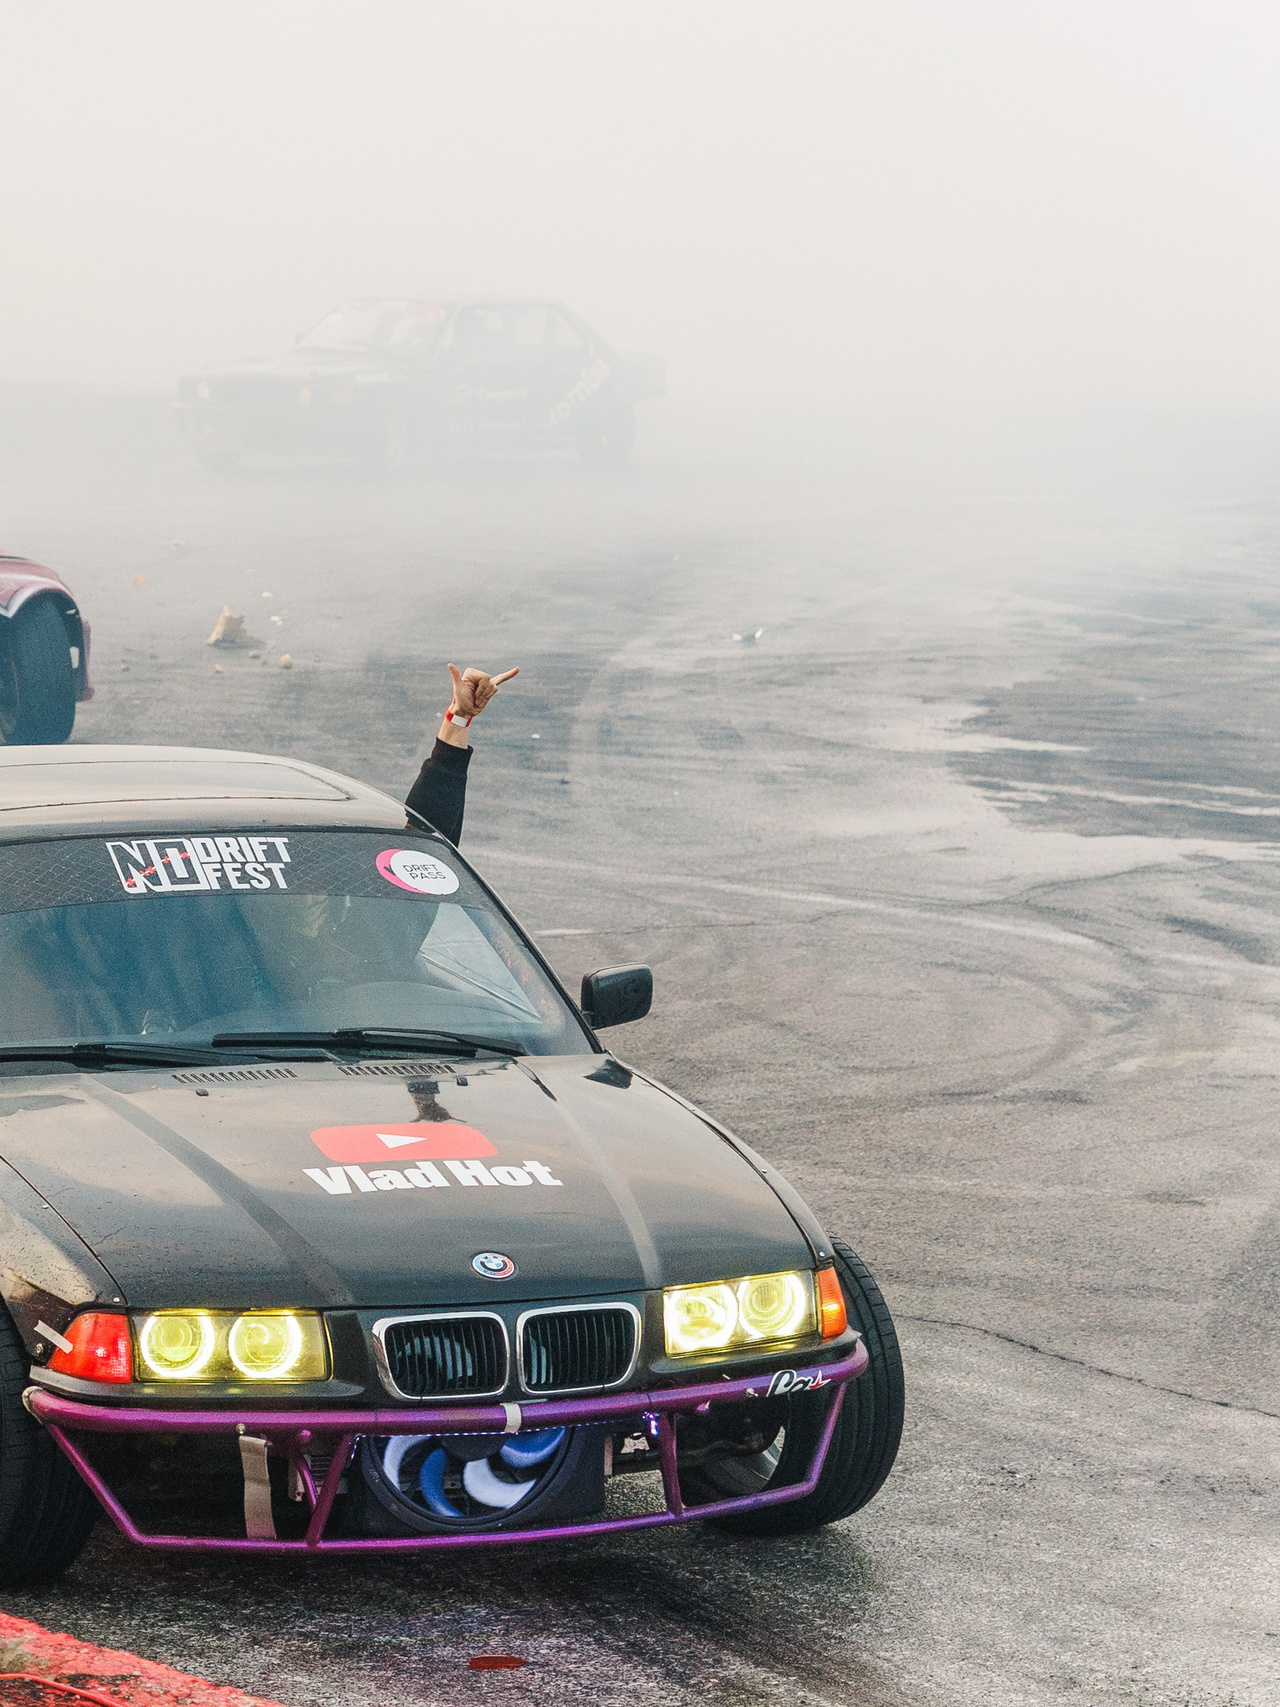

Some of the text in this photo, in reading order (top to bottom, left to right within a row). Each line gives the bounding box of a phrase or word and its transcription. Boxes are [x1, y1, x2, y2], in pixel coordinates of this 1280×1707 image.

[190, 837, 292, 863] DRIFT
[202, 862, 288, 890] FEST
[402, 864, 439, 873] DRIFT
[409, 871, 447, 881] PASS
[302, 1160, 564, 1195] Vlad Hot
